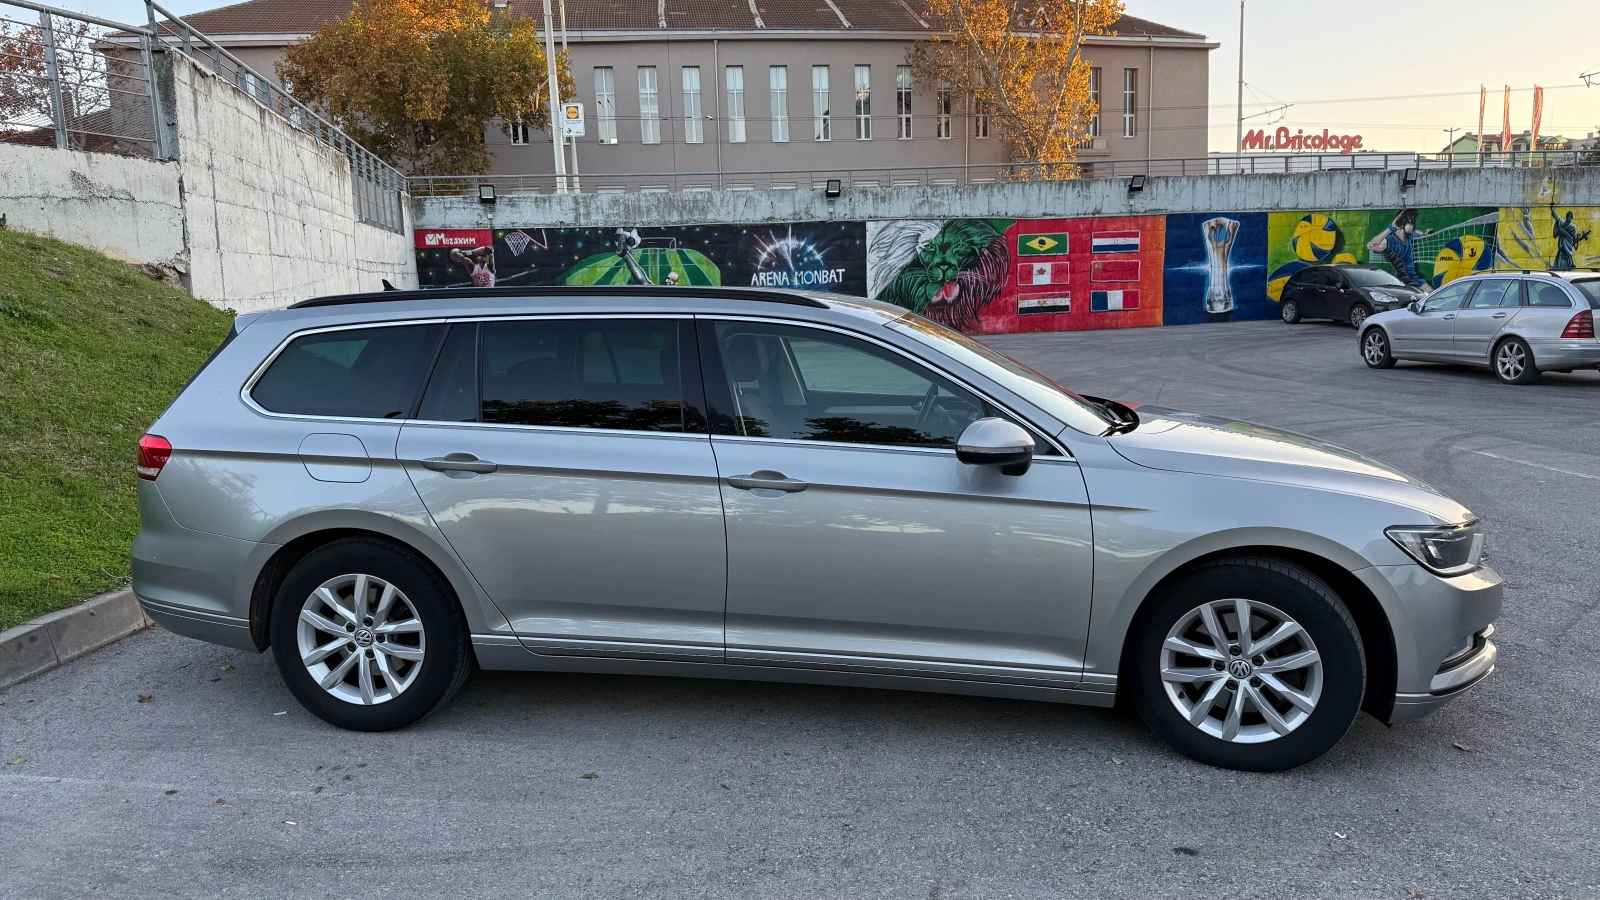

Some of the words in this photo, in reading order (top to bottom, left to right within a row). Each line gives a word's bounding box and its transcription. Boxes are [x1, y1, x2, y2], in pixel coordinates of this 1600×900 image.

[435, 233, 476, 246] Мегахим
[474, 273, 490, 286] 23
[750, 271, 790, 286] ARENA
[794, 268, 846, 286] MONBAT
